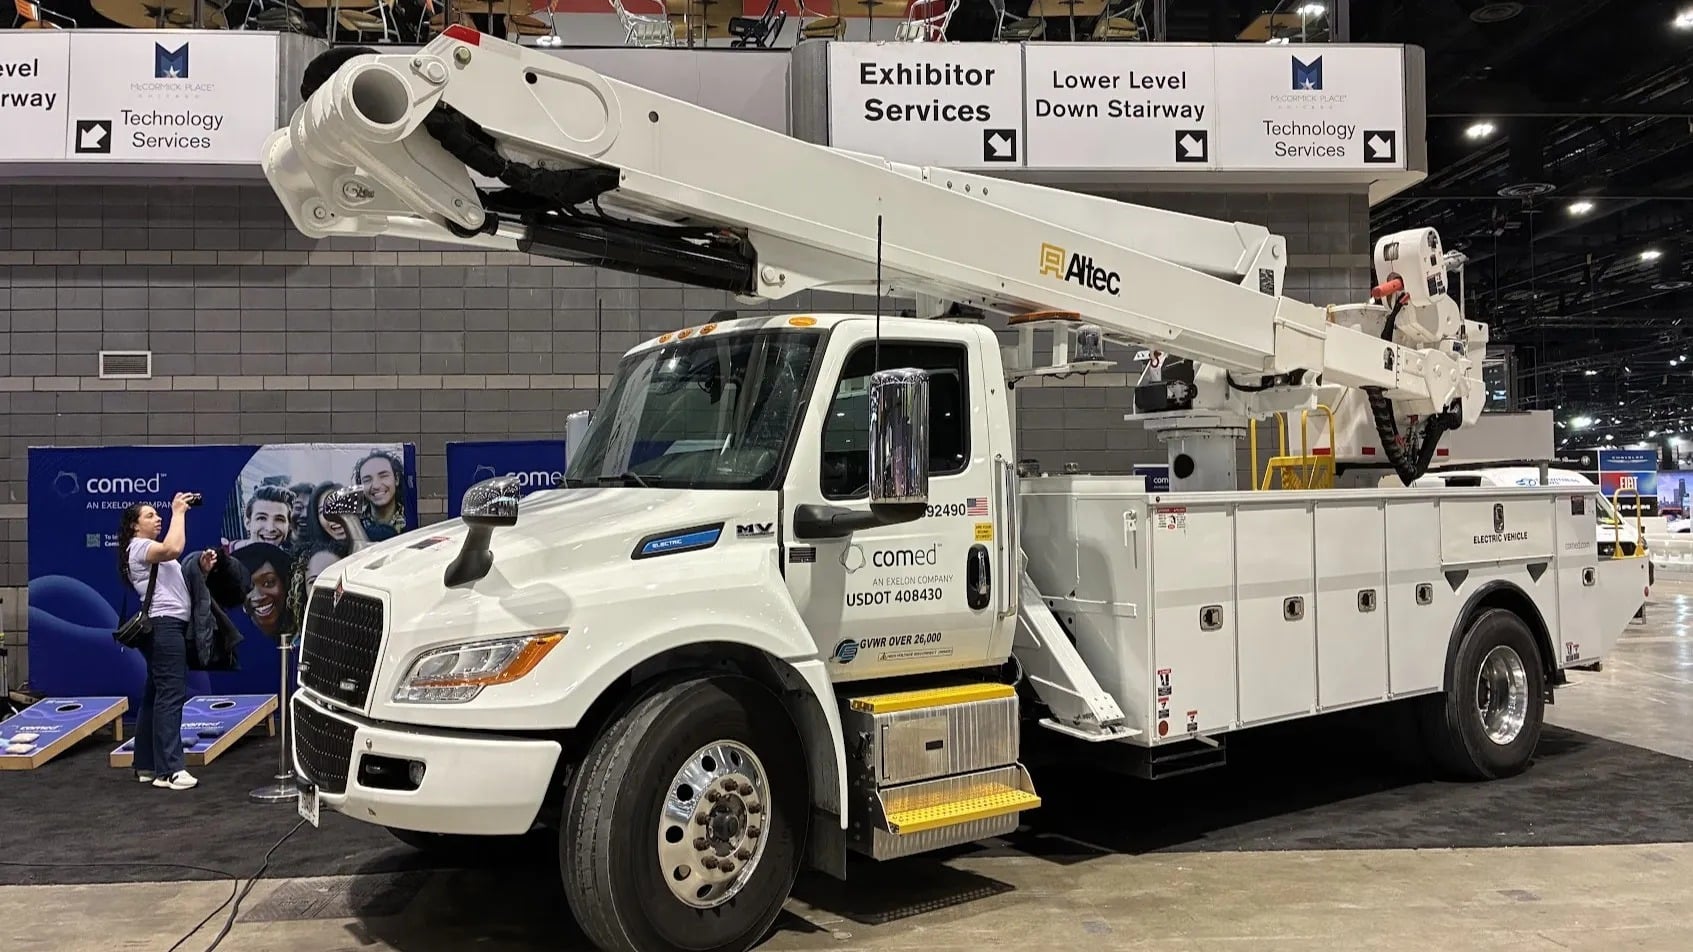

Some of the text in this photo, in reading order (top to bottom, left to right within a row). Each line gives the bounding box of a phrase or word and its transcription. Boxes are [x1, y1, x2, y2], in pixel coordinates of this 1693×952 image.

[0, 58, 38, 77] vel
[860, 63, 995, 85] Exhibitor
[1053, 70, 1186, 89] Lower Level
[864, 98, 991, 121] Services
[1036, 99, 1205, 121] Down Stairway
[120, 109, 223, 130] Technology
[132, 131, 211, 148] Services
[1262, 120, 1355, 140] Technology
[1274, 141, 1345, 157] Services
[1064, 252, 1121, 295] Altec
[86, 473, 160, 493] comed
[506, 471, 562, 486] ome
[1620, 476, 1638, 491] FIAT
[86, 501, 99, 509] AN
[737, 523, 774, 534] MV
[1473, 531, 1528, 544] ELECTRIC VEHICLE
[652, 538, 682, 548] ELECTRIC
[872, 543, 937, 567] comed
[872, 574, 953, 586] AN EXELON COMPANY
[846, 587, 943, 607] USDOT 408430
[860, 632, 942, 649] GVWR OVER 26,000
